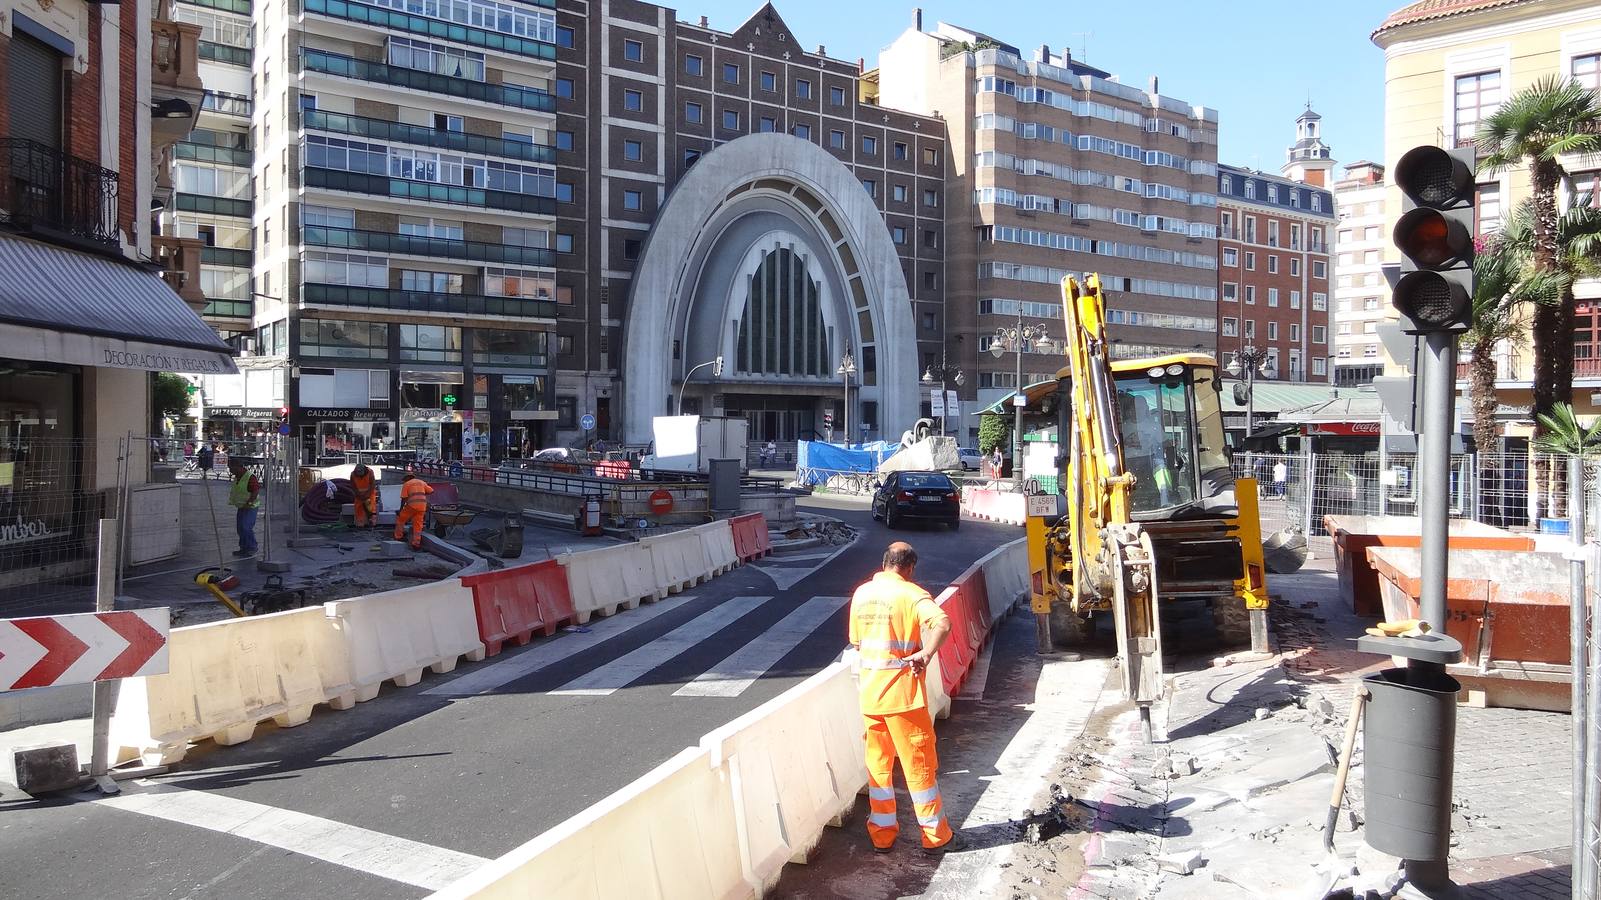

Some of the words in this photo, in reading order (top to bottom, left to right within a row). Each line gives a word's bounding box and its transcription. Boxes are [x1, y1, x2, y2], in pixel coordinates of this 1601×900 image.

[103, 349, 172, 369] DECORACIÓN
[173, 356, 181, 369] Y
[181, 358, 220, 372] REGALOS
[1023, 479, 1038, 496] 40
[1030, 497, 1035, 506] E
[0, 514, 51, 540] mber
